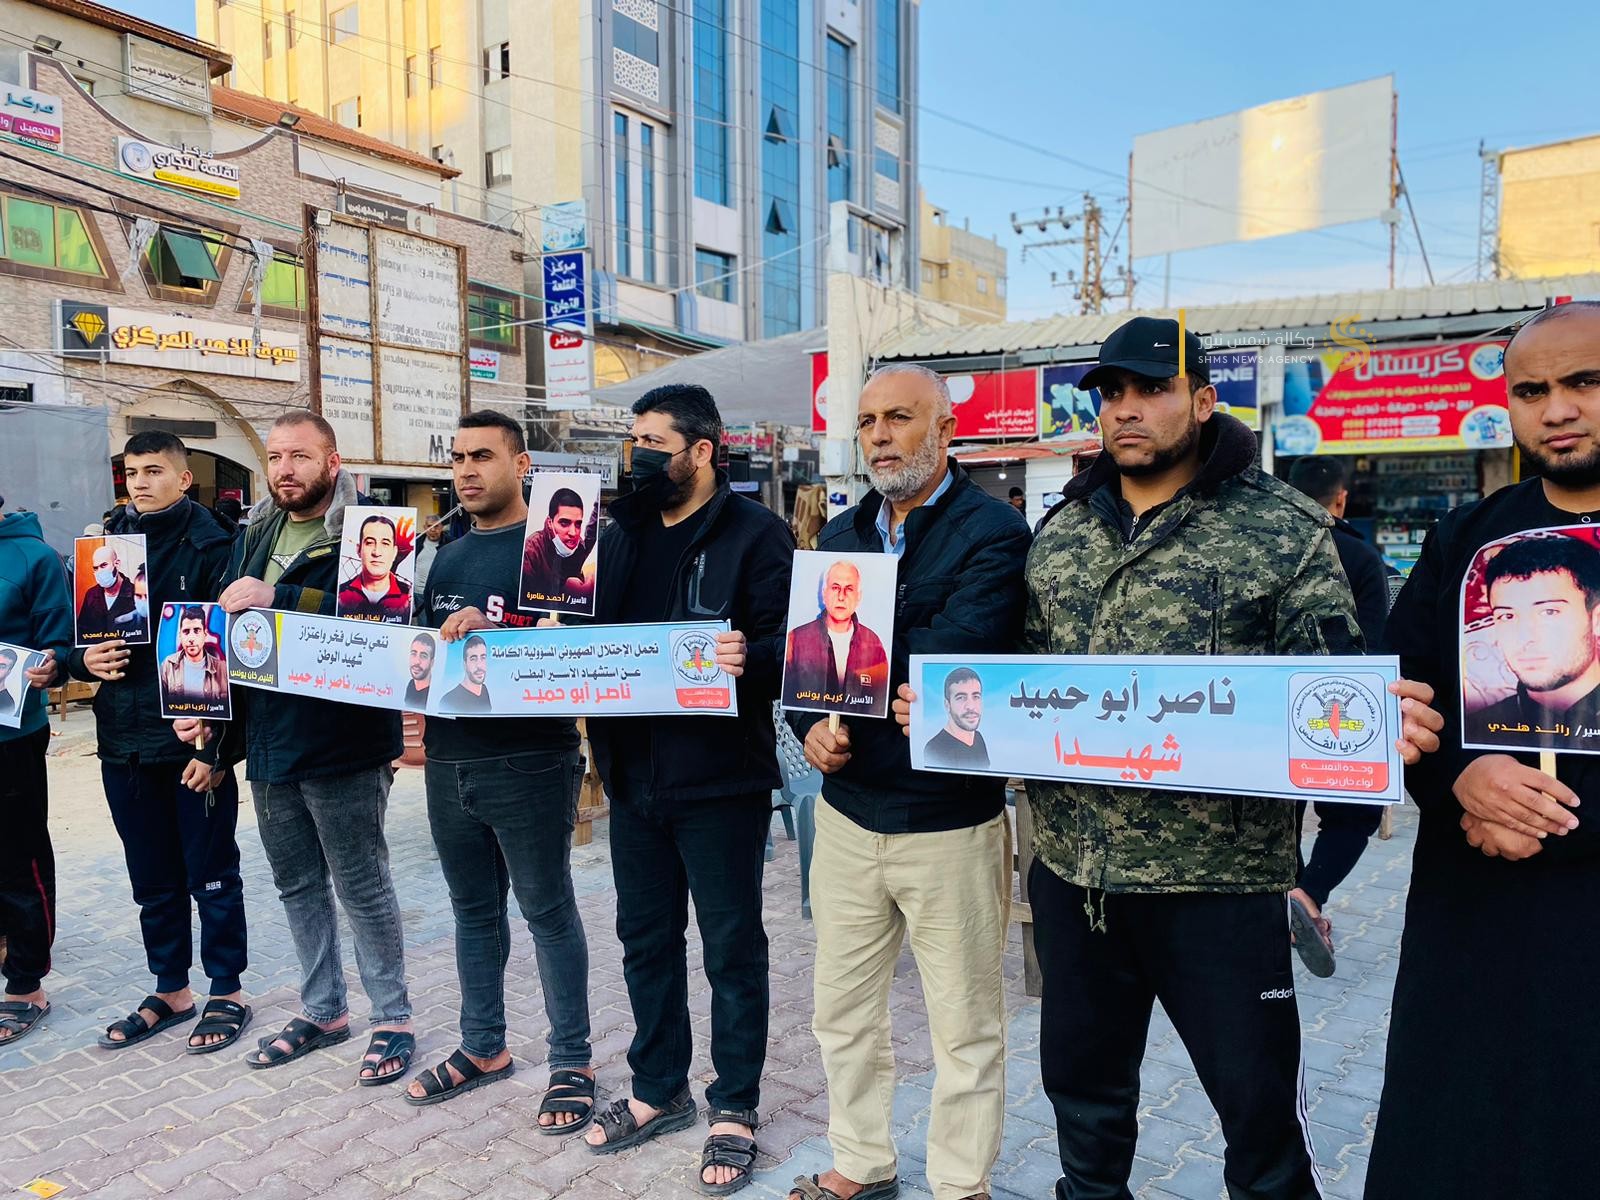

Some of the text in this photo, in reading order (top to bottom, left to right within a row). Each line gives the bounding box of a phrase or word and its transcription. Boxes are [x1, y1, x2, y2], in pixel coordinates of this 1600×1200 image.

[20, 123, 54, 138] للتجميل
[152, 152, 239, 181] القلعة التجاري
[550, 260, 576, 276] مركز
[552, 279, 577, 292] القلعة
[550, 297, 580, 318] التجاري
[112, 325, 193, 352] المركزي
[197, 337, 252, 357] الذهب
[255, 339, 298, 365] سوق
[1354, 350, 1465, 381] كريستال
[299, 626, 388, 652] ننعي بكل فخر واعتزاز
[492, 644, 523, 660] الكاملة
[558, 645, 596, 662] الصهيوني
[635, 643, 659, 656] نحمل
[317, 650, 363, 668] شهيد الوطن
[230, 669, 246, 680] يونس
[248, 671, 258, 680] خان
[288, 670, 352, 690] ناصر أبو حميد
[548, 668, 580, 681] الأسير
[581, 668, 620, 680] استشهاد
[621, 668, 642, 678] عن
[522, 684, 631, 702] ناصر أبو حميد
[796, 690, 821, 702] يونس
[823, 693, 843, 704] كريم
[1008, 670, 1236, 725] ناصر أبو حميد
[1488, 722, 1530, 732] هندي
[1534, 723, 1570, 736] رائد
[1260, 988, 1294, 1000] adidas
